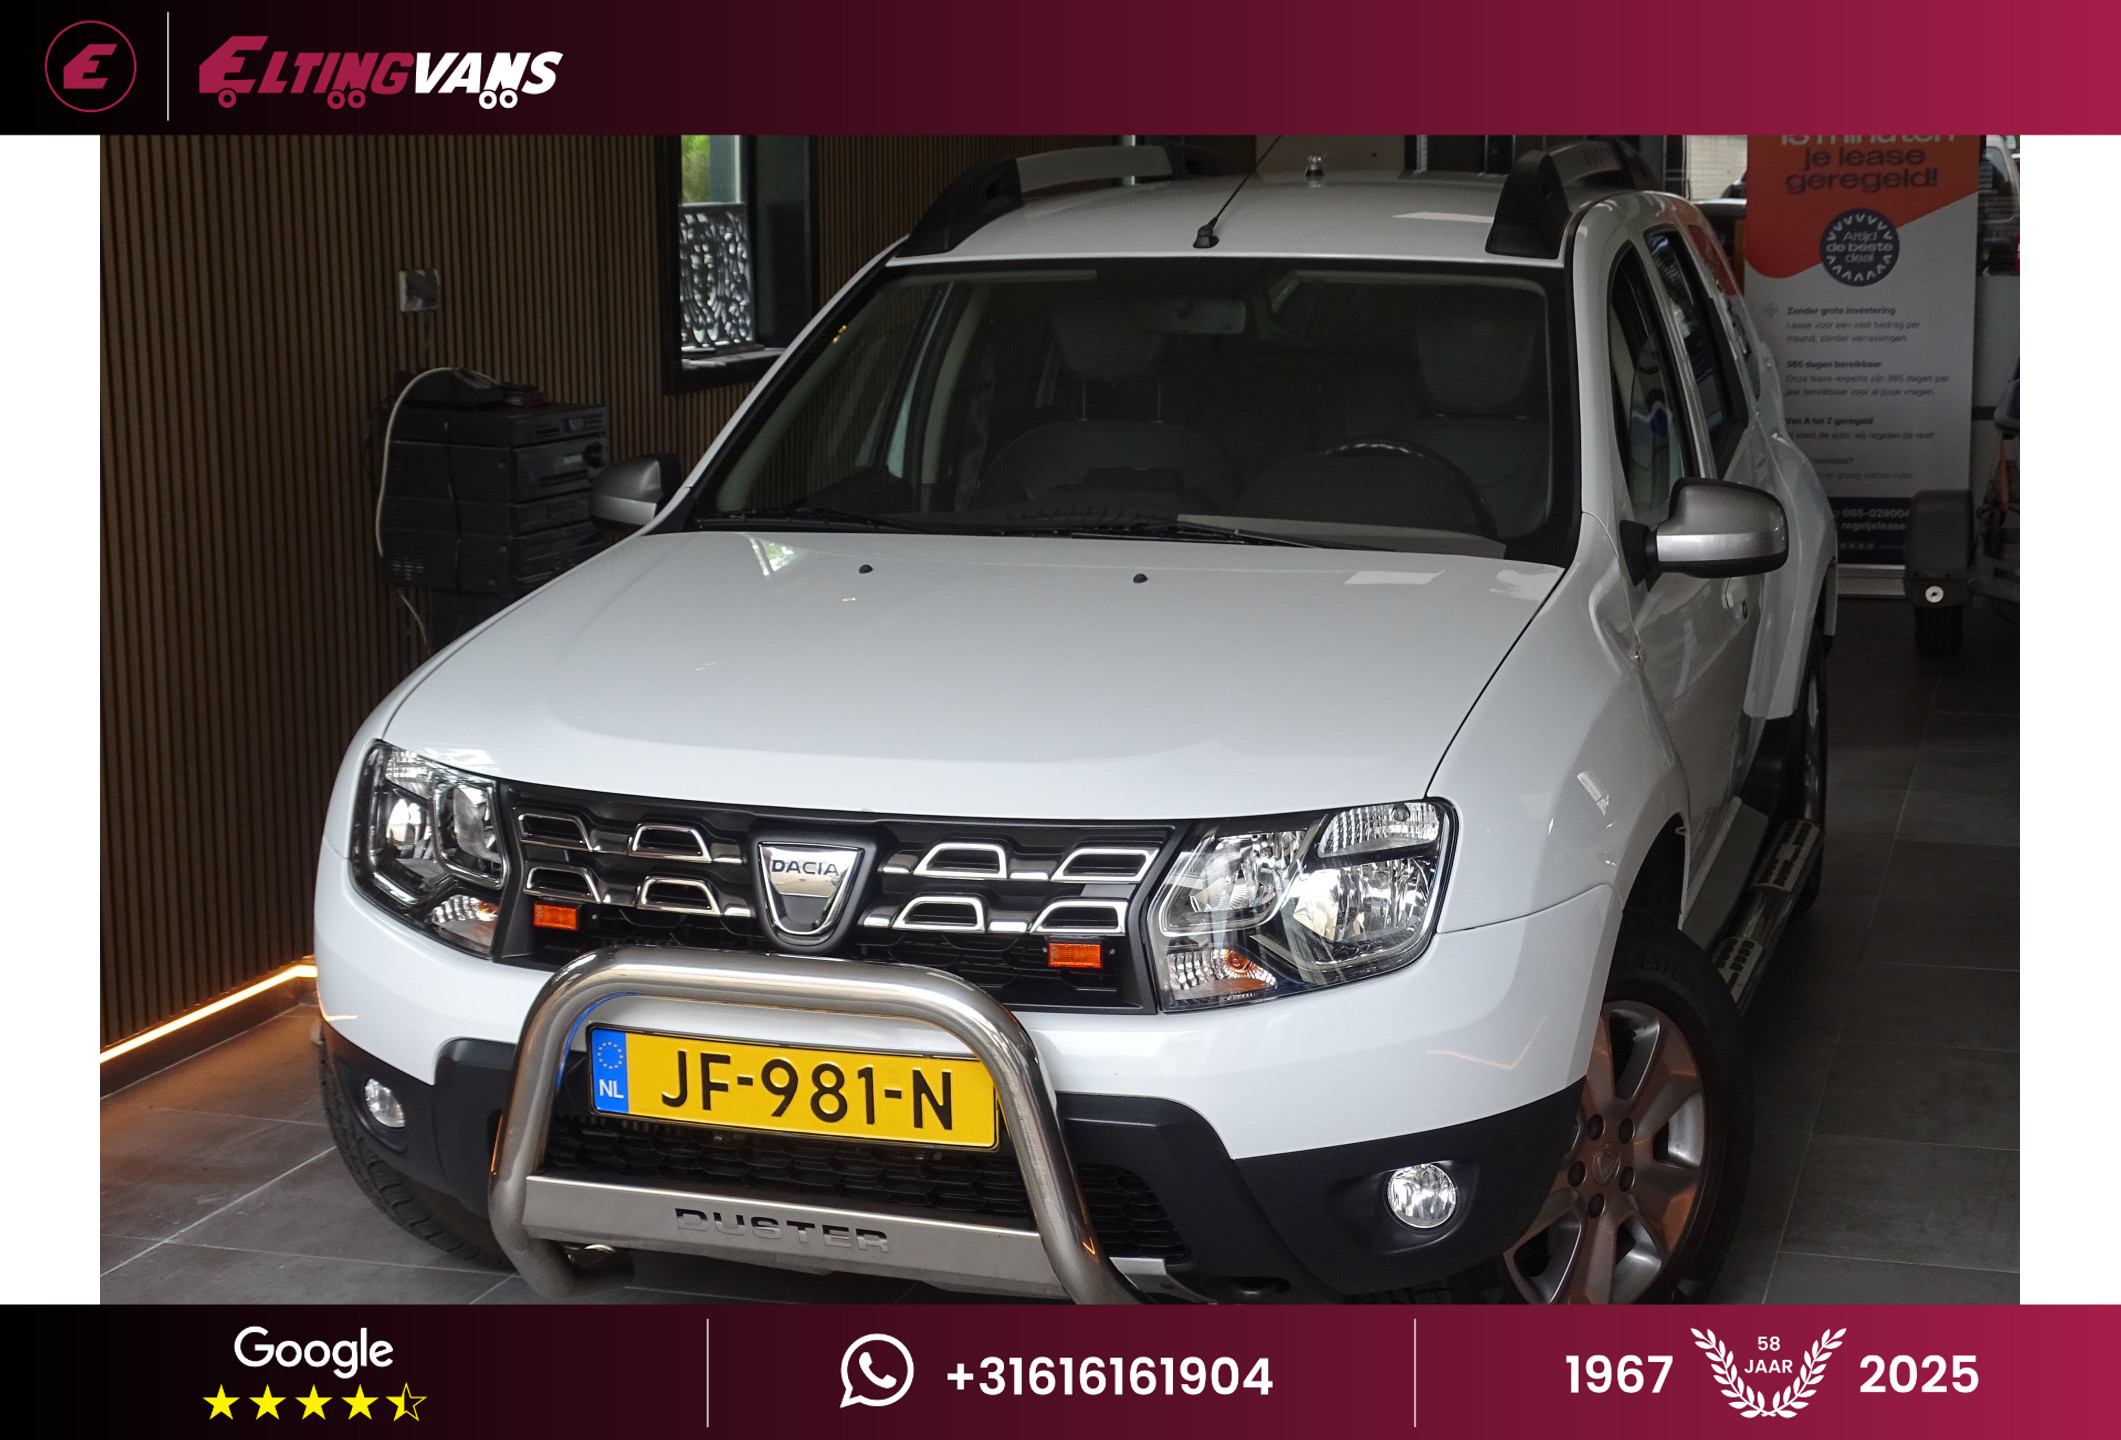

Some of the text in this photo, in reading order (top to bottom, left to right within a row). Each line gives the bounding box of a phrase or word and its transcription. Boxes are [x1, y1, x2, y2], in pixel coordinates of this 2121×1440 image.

[1802, 146, 1926, 172] je lease
[1784, 167, 1938, 195] geregeld!
[1842, 231, 1878, 243] Altijd
[1826, 242, 1893, 253] de beste
[1844, 252, 1875, 263] deal
[1787, 306, 1897, 317] Zonder grote investering
[1906, 321, 1921, 331] per
[1820, 334, 1849, 343] zonder
[1786, 360, 1882, 370] 365 dagen bereikbaar
[1888, 374, 1903, 383] 365
[1906, 375, 1933, 385] dagen
[1935, 375, 1950, 385] per
[1785, 416, 1802, 425] Van
[1834, 417, 1874, 427] geregeld
[771, 859, 840, 877] DACIA
[599, 1078, 624, 1100] NL
[661, 1049, 954, 1131] JF-981-N
[674, 1207, 890, 1254] DUSTER
